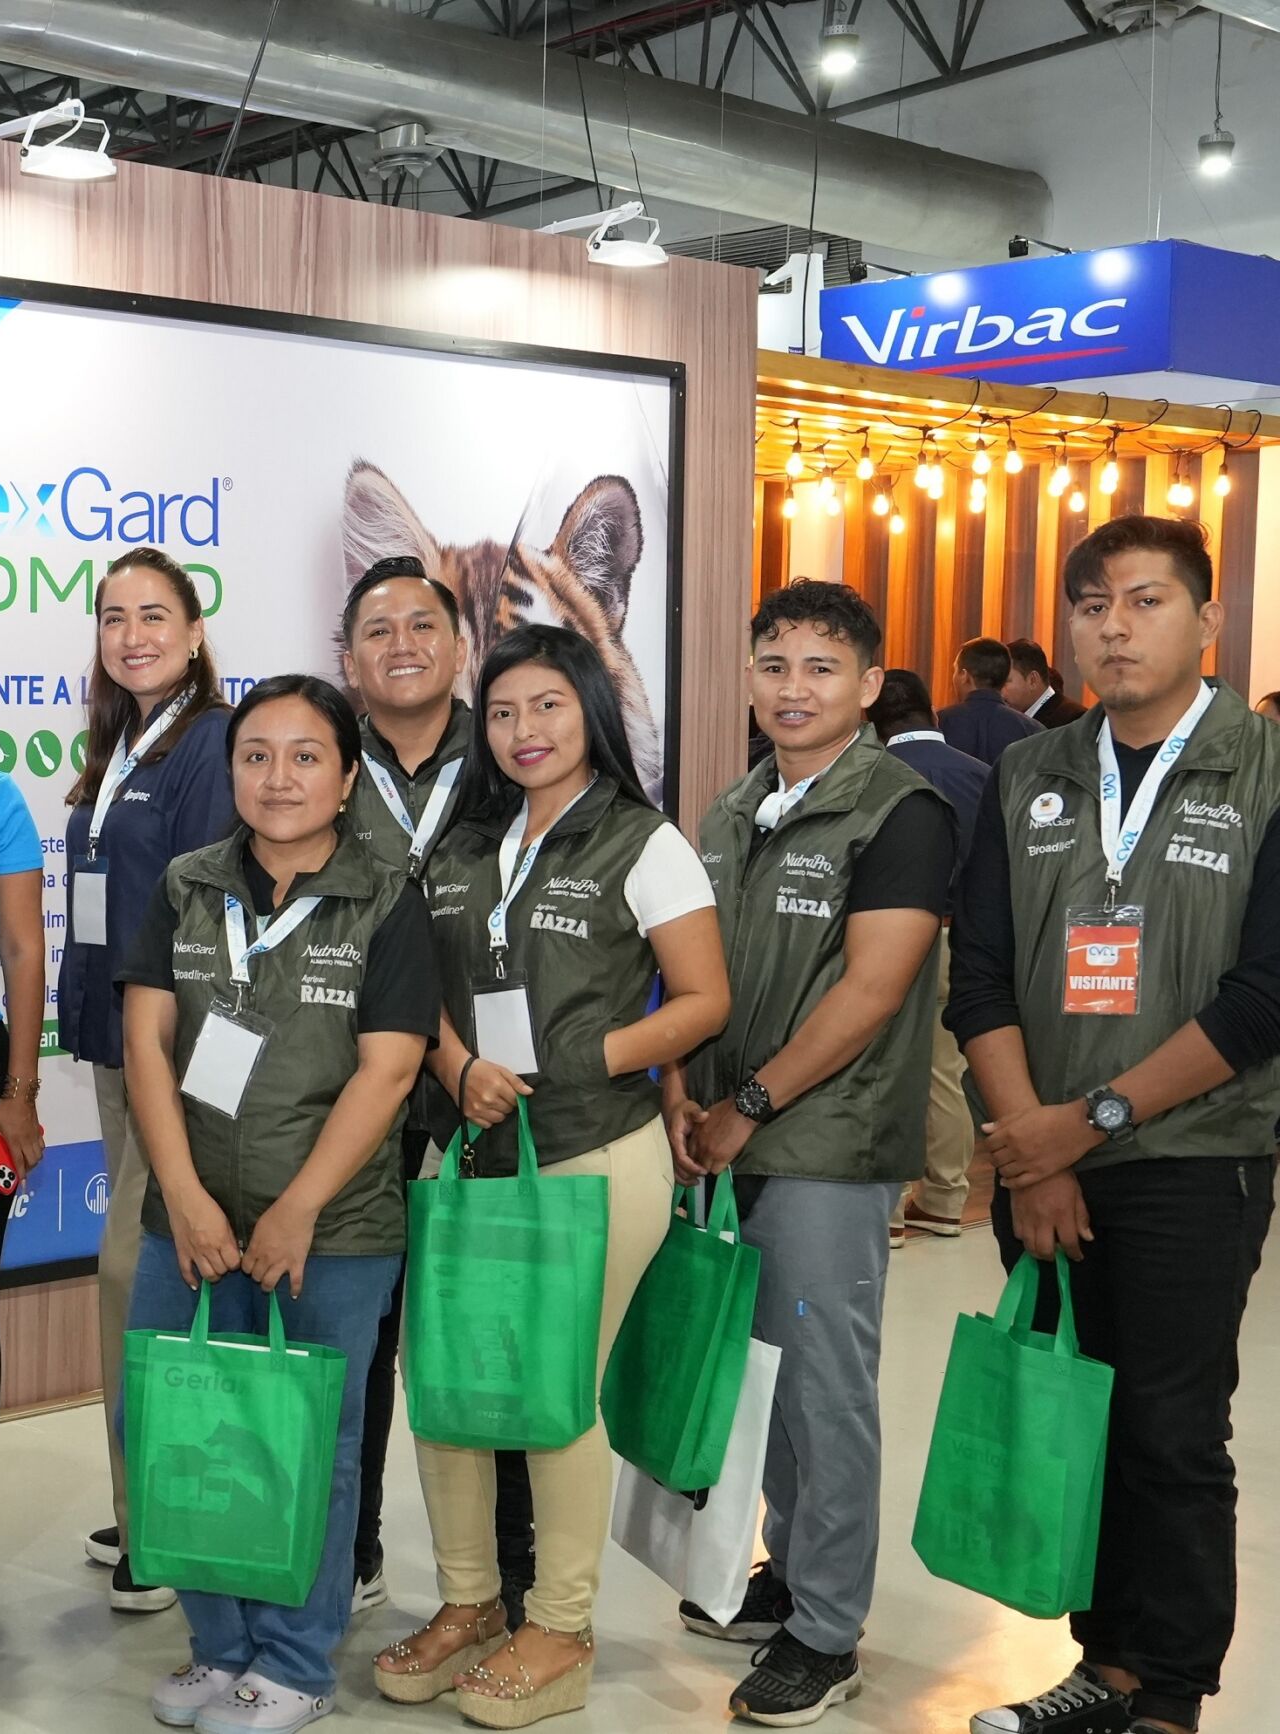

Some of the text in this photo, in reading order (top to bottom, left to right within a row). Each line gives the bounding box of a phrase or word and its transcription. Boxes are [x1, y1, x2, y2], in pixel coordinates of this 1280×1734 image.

[841, 298, 1128, 365] Virbac
[53, 676, 71, 705] A
[1174, 798, 1241, 823] NutraPro
[780, 852, 832, 872] NutraPro
[1165, 843, 1229, 875] RAZZA
[541, 876, 600, 892] NutraPro
[775, 895, 832, 919] RAZZA
[529, 911, 588, 940] RAZZA
[173, 941, 217, 955] NexGard
[301, 943, 361, 961] NutraPro
[1069, 975, 1136, 991] VISITANTE
[301, 985, 357, 1009] RAZZA
